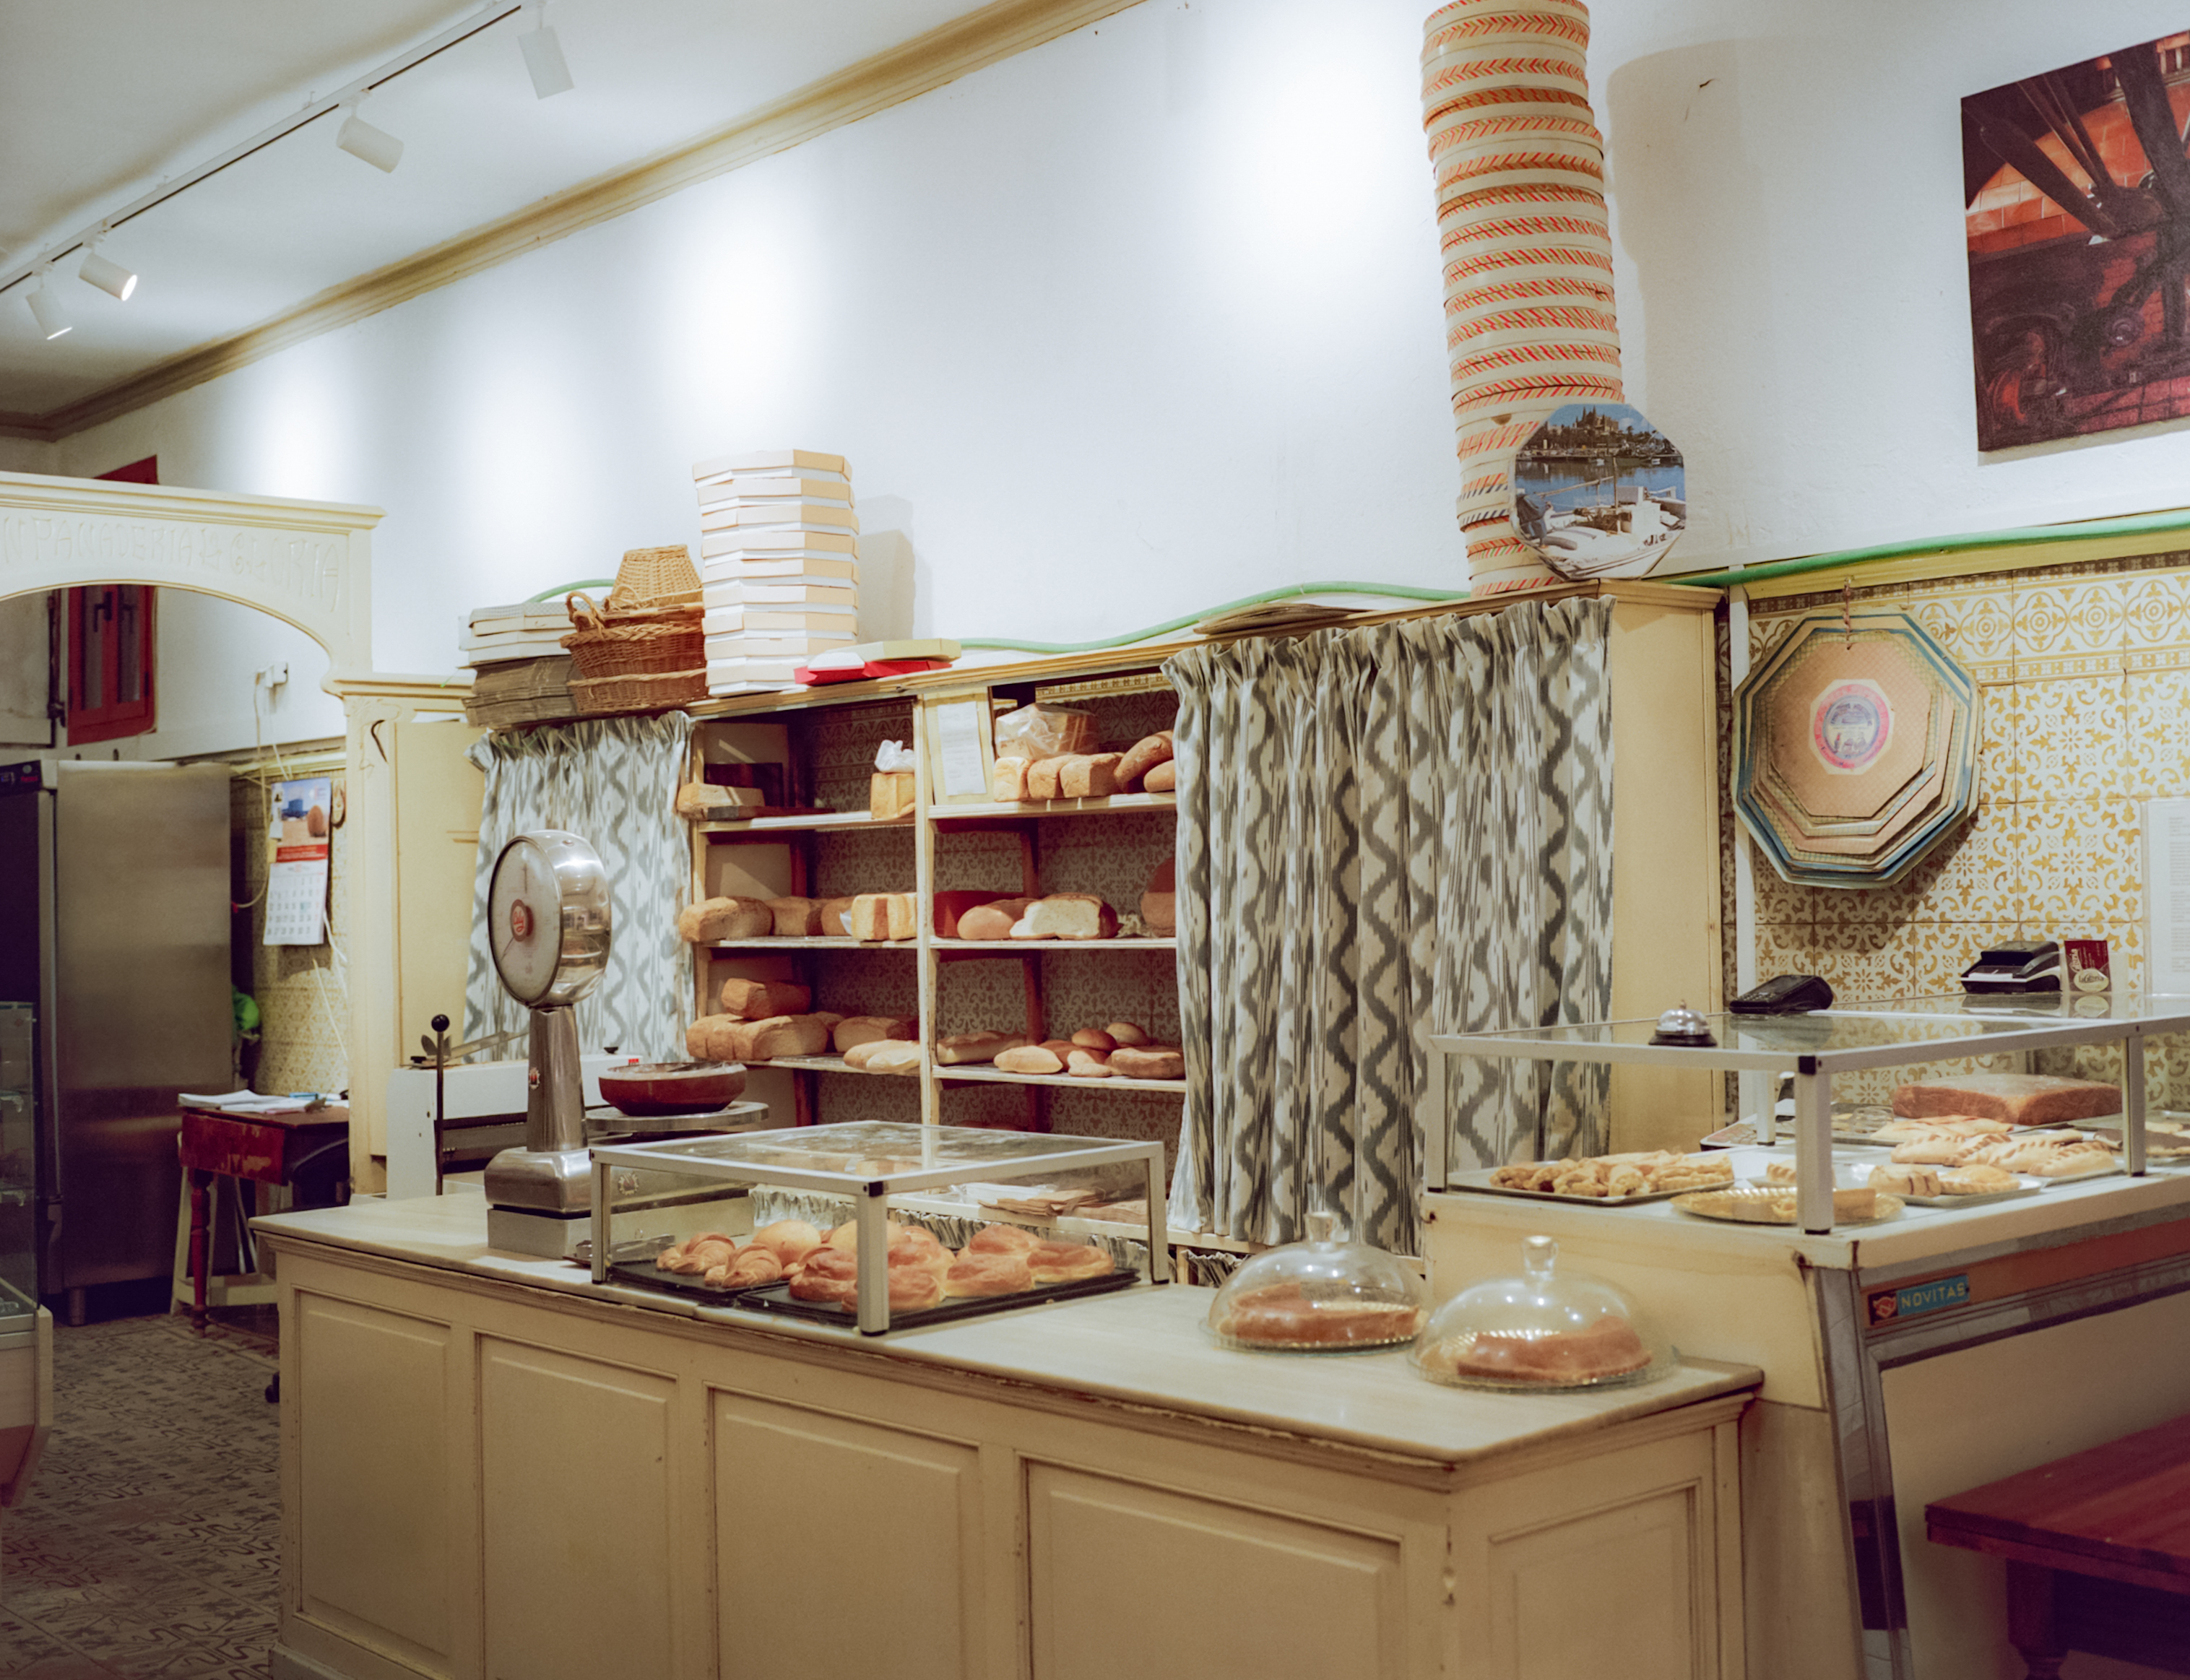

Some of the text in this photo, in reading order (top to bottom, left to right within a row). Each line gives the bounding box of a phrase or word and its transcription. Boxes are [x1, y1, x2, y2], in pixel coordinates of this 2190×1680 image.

[31, 515, 193, 567] PANADERIA
[230, 532, 342, 613] GLORIA
[1901, 1282, 1965, 1308] NOVITAS
